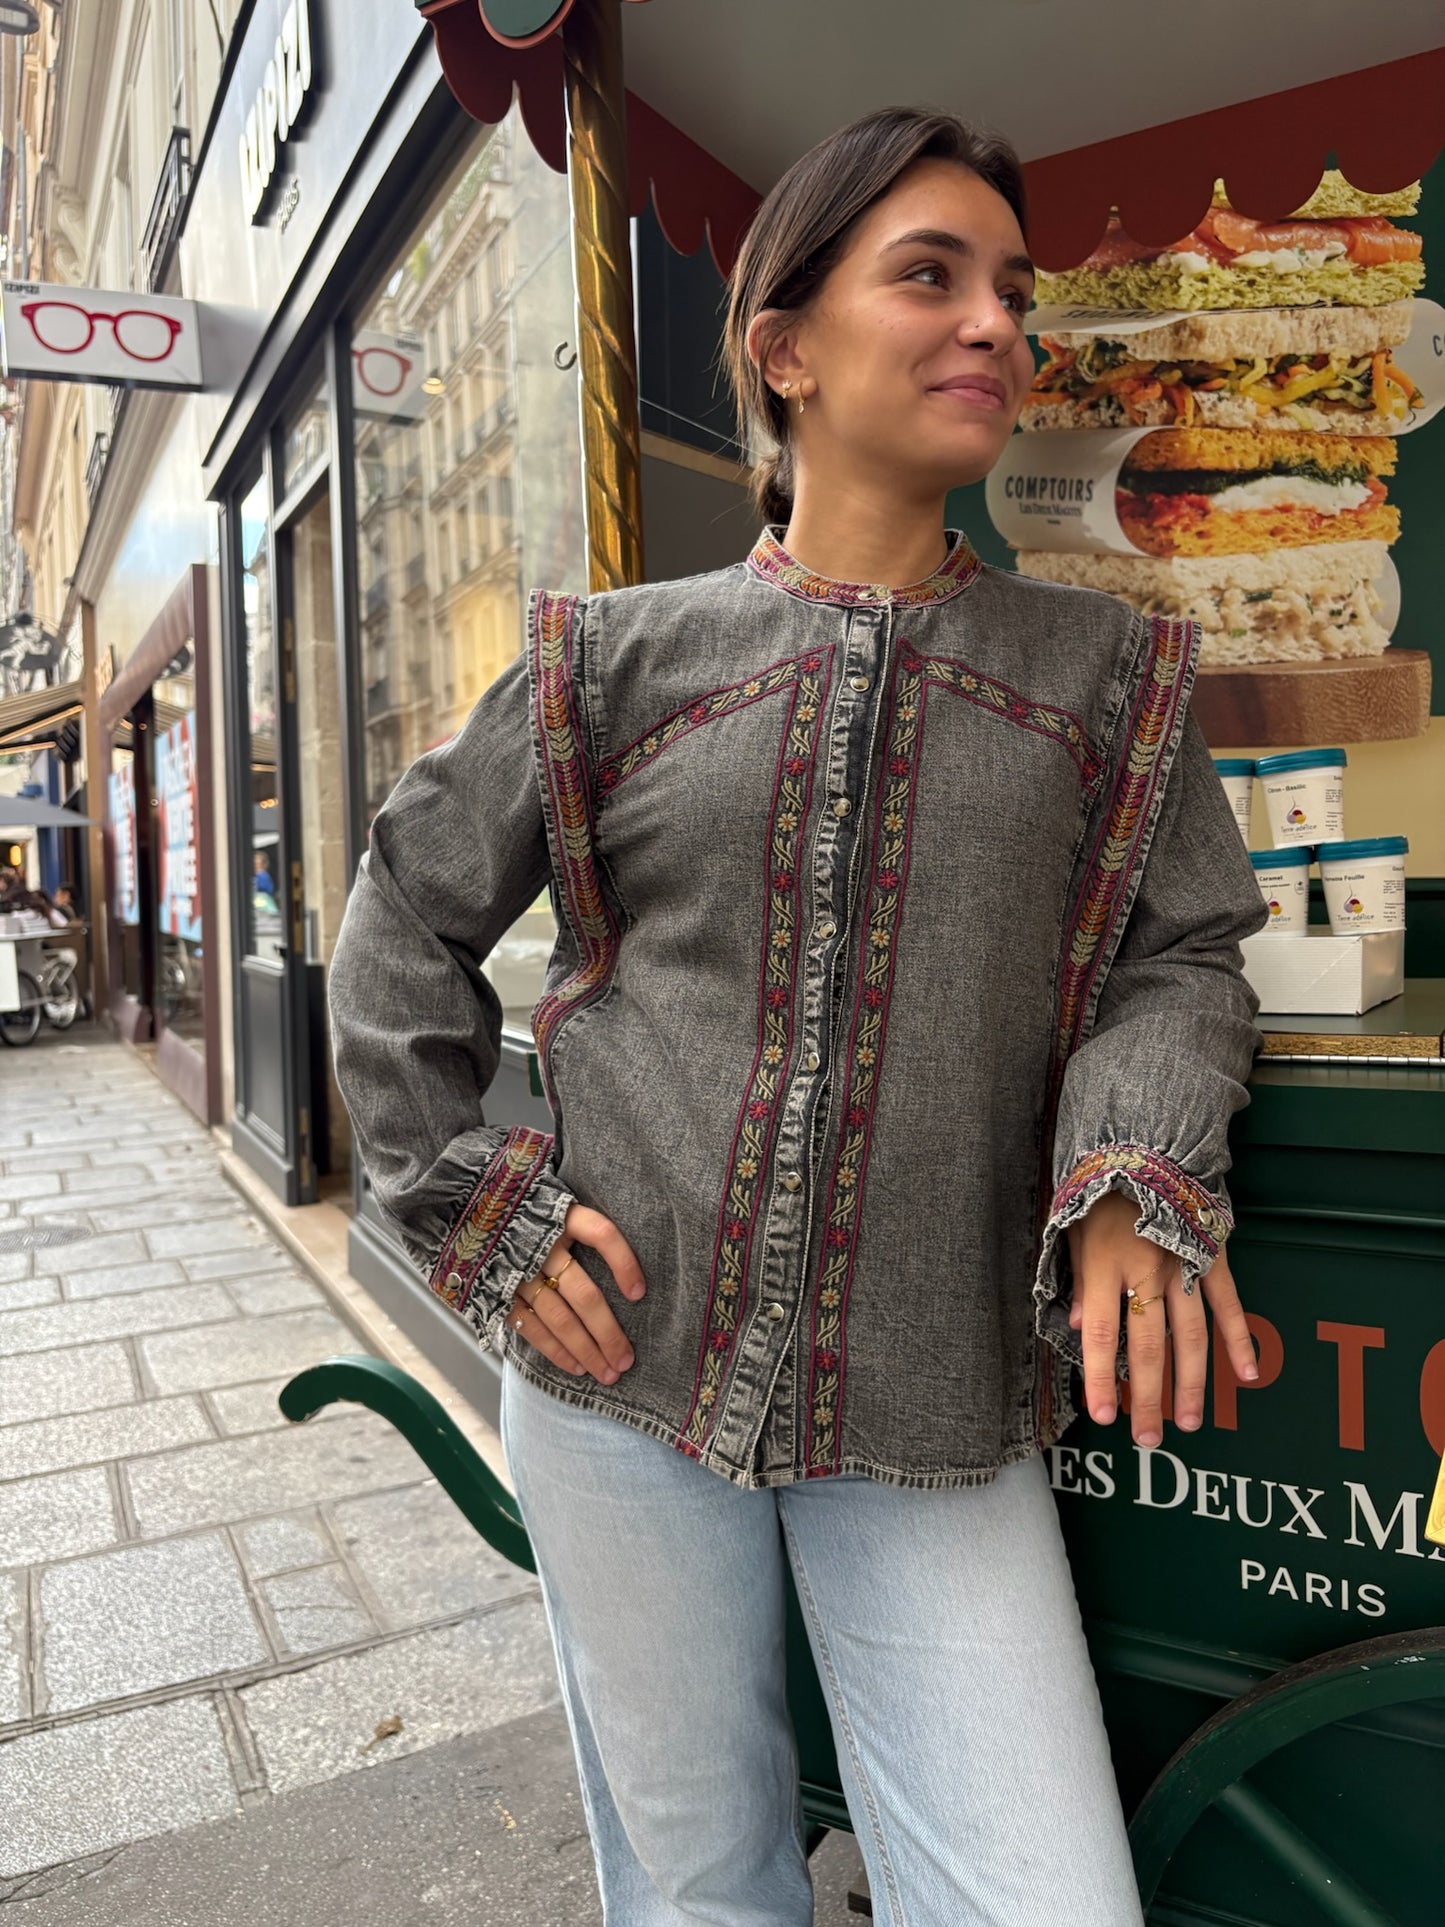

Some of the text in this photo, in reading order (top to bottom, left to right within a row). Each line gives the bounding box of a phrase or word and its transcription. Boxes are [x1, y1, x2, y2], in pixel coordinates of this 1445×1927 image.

[1005, 475, 1094, 502] COMPTOIRS
[1050, 1445, 1445, 1562] ES DEUX M
[1240, 1559, 1387, 1617] PARIS
